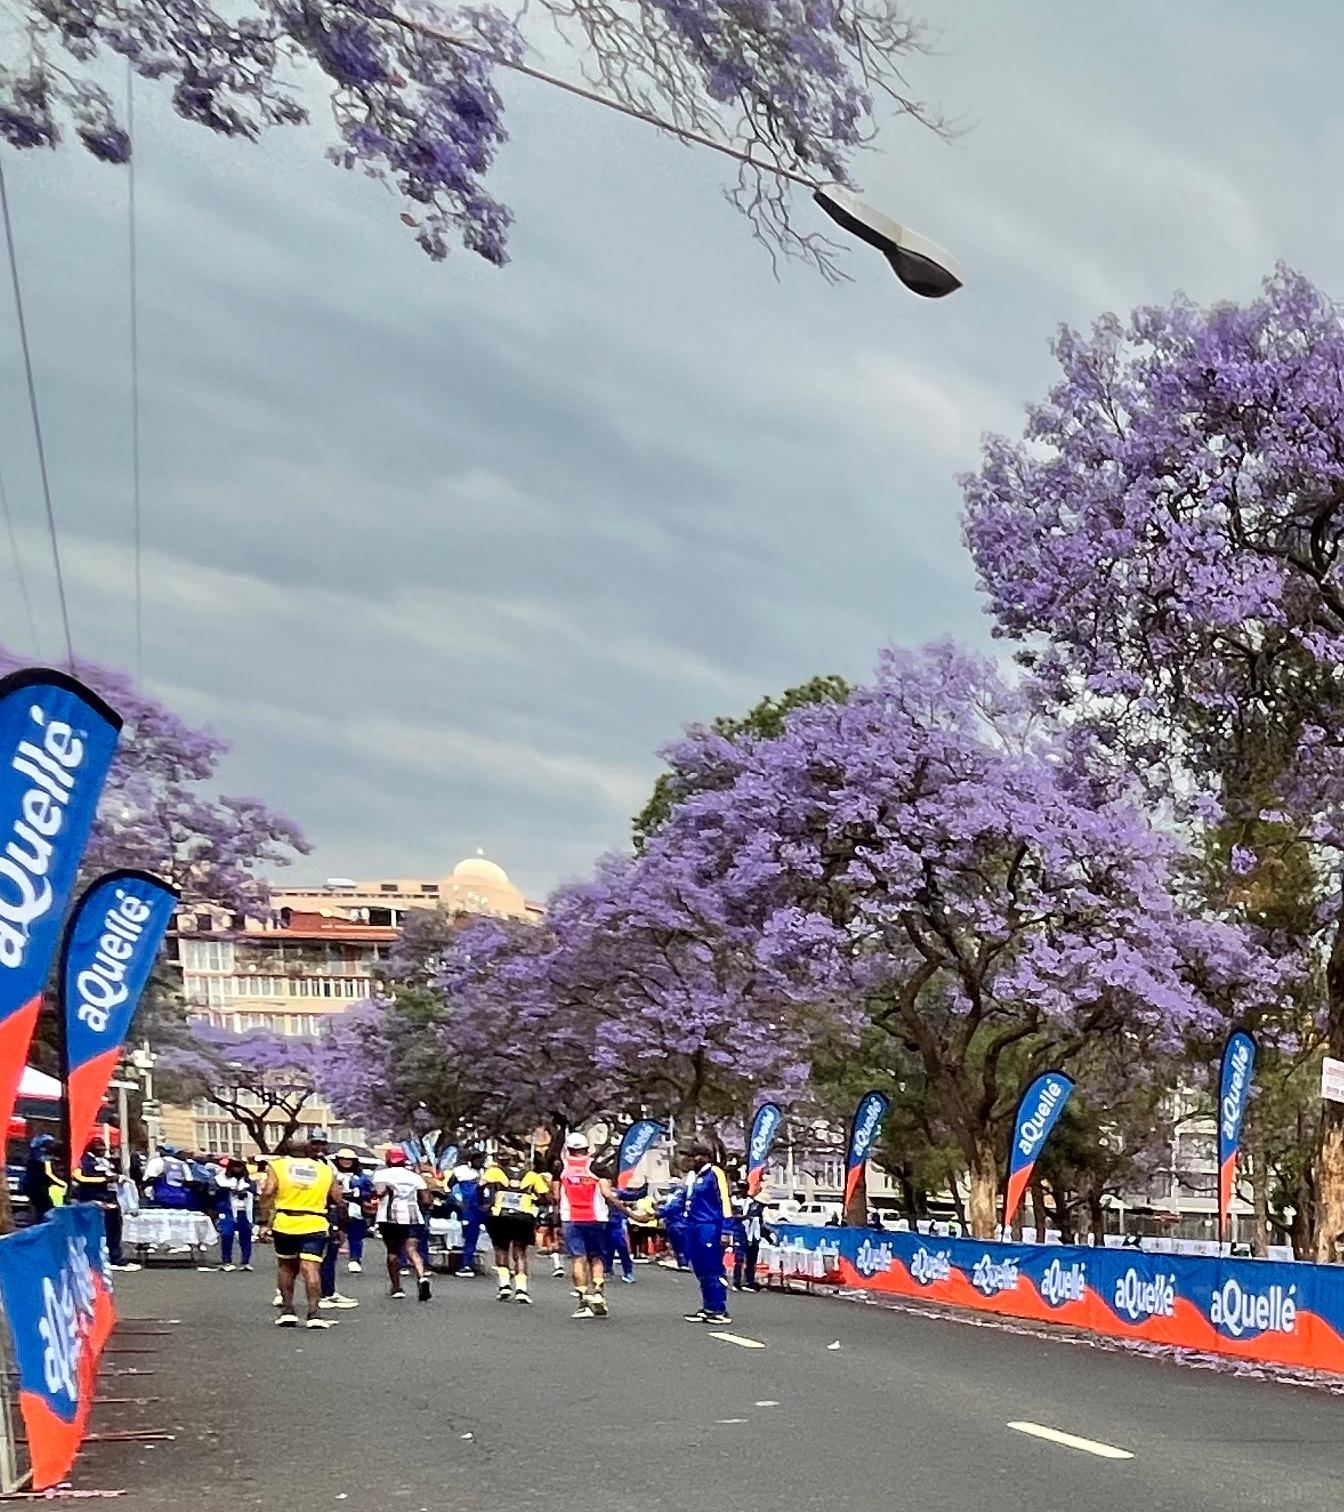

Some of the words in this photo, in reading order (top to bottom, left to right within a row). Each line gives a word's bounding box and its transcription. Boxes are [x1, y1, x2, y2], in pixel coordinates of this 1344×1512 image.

[0, 704, 84, 968] aQuellé
[77, 888, 150, 1032] aQuellé
[1018, 1078, 1061, 1155] aQuellé
[1223, 1040, 1250, 1139] aQuellé
[1114, 1268, 1176, 1320] aQuellé
[1210, 1279, 1297, 1337] aQuellé
